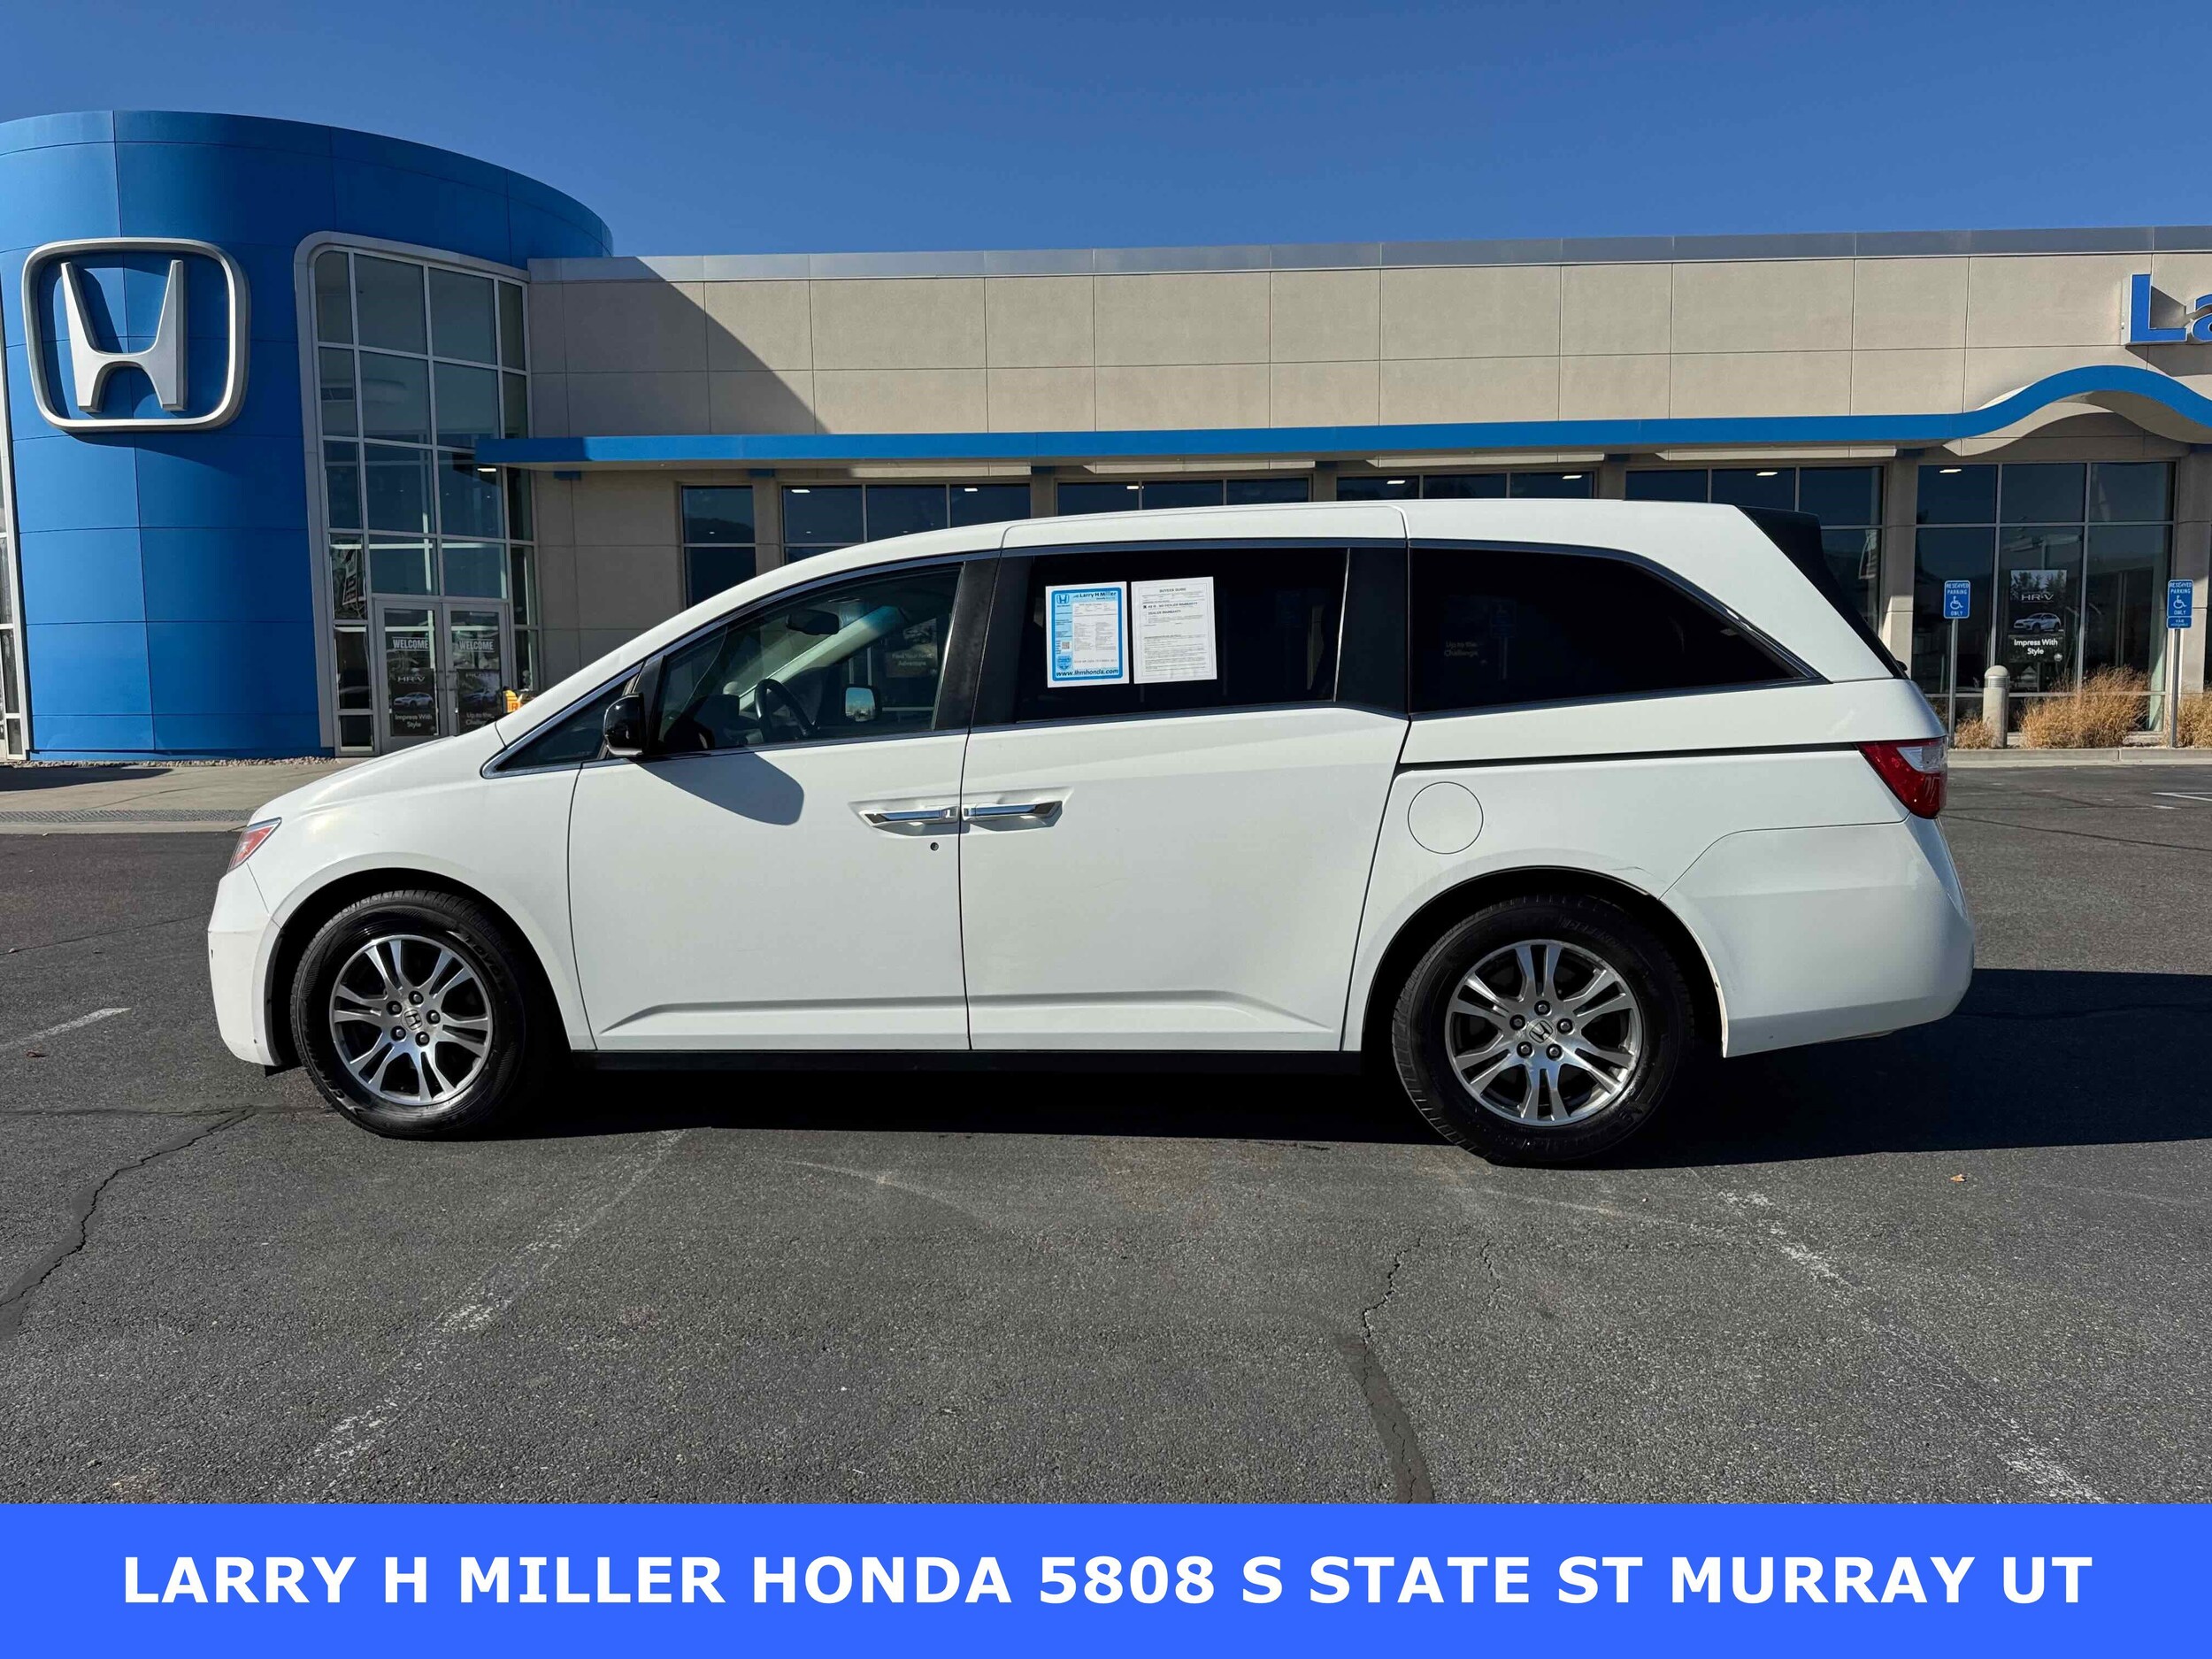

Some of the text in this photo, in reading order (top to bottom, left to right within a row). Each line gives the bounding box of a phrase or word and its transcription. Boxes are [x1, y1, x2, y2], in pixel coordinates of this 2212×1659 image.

[393, 639, 429, 649] WELCOME
[459, 641, 494, 650] WELCOME
[2014, 637, 2058, 648] Impress With
[2027, 647, 2045, 656] Style
